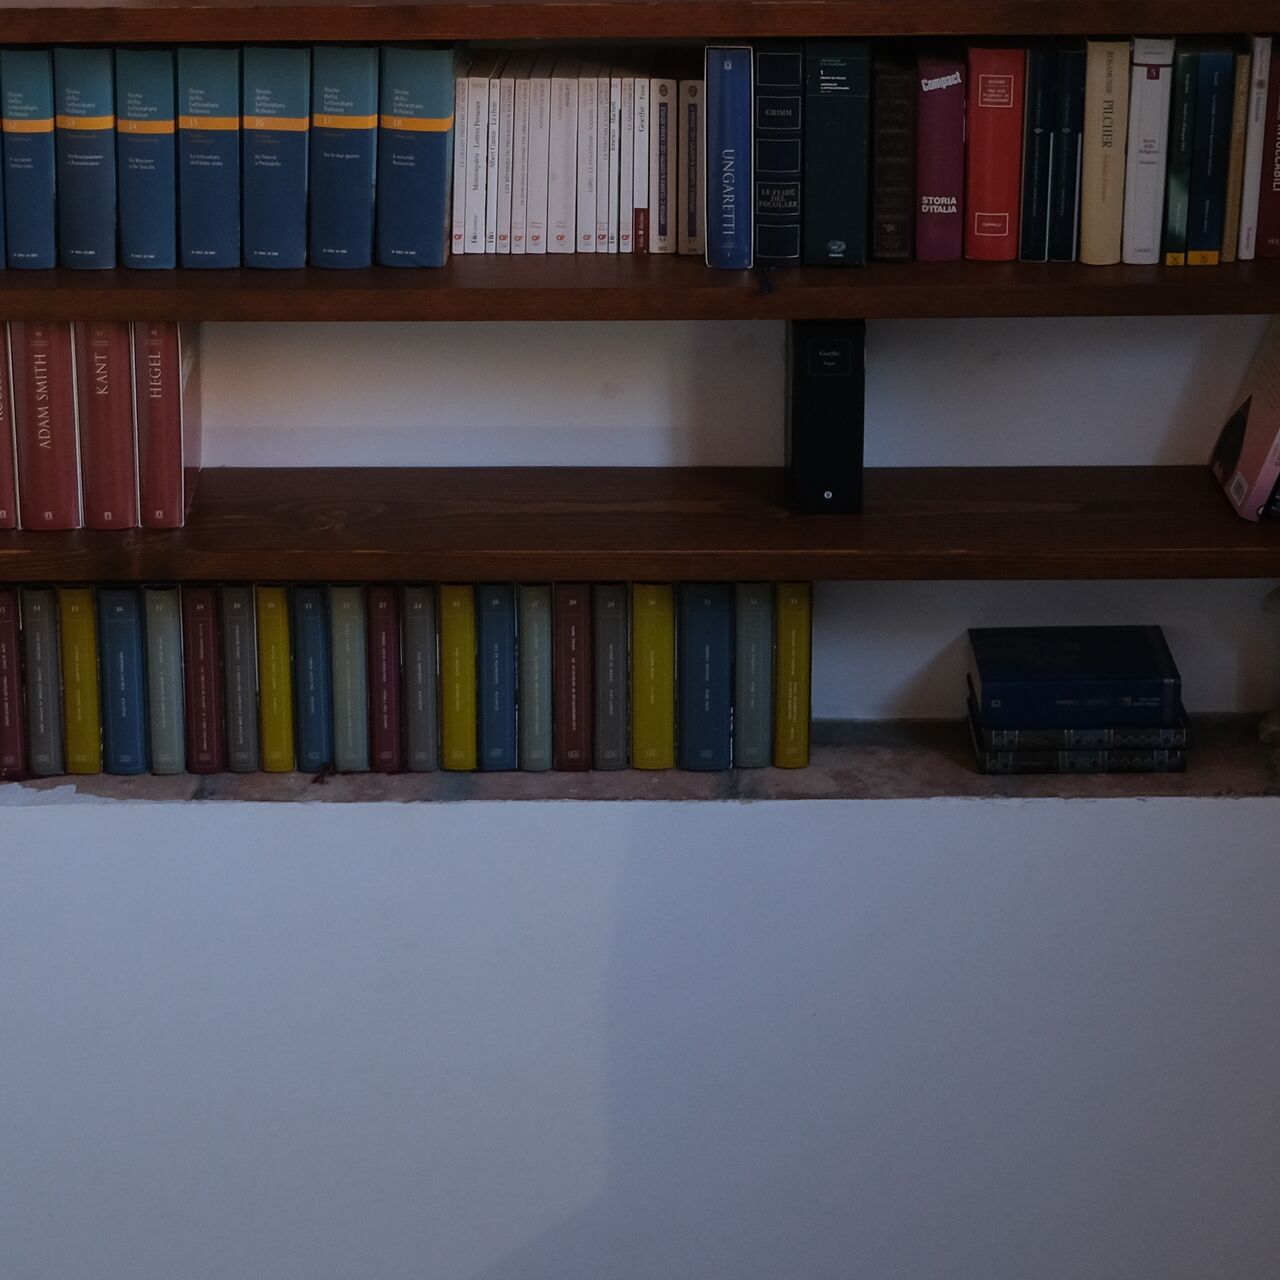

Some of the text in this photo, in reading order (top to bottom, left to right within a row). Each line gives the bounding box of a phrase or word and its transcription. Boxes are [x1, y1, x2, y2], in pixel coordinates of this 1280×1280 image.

[921, 71, 962, 92] Compact
[638, 106, 646, 132] Goethe
[765, 108, 792, 118] GRIMM
[1101, 100, 1114, 148] PILCHER
[721, 148, 736, 235] UNGARETTI
[922, 196, 957, 205] STORIA
[922, 204, 957, 213] D'ITALIA
[94, 352, 109, 395] KANT
[149, 351, 163, 398] HEGEL
[34, 354, 51, 449] ADAM SMITH
